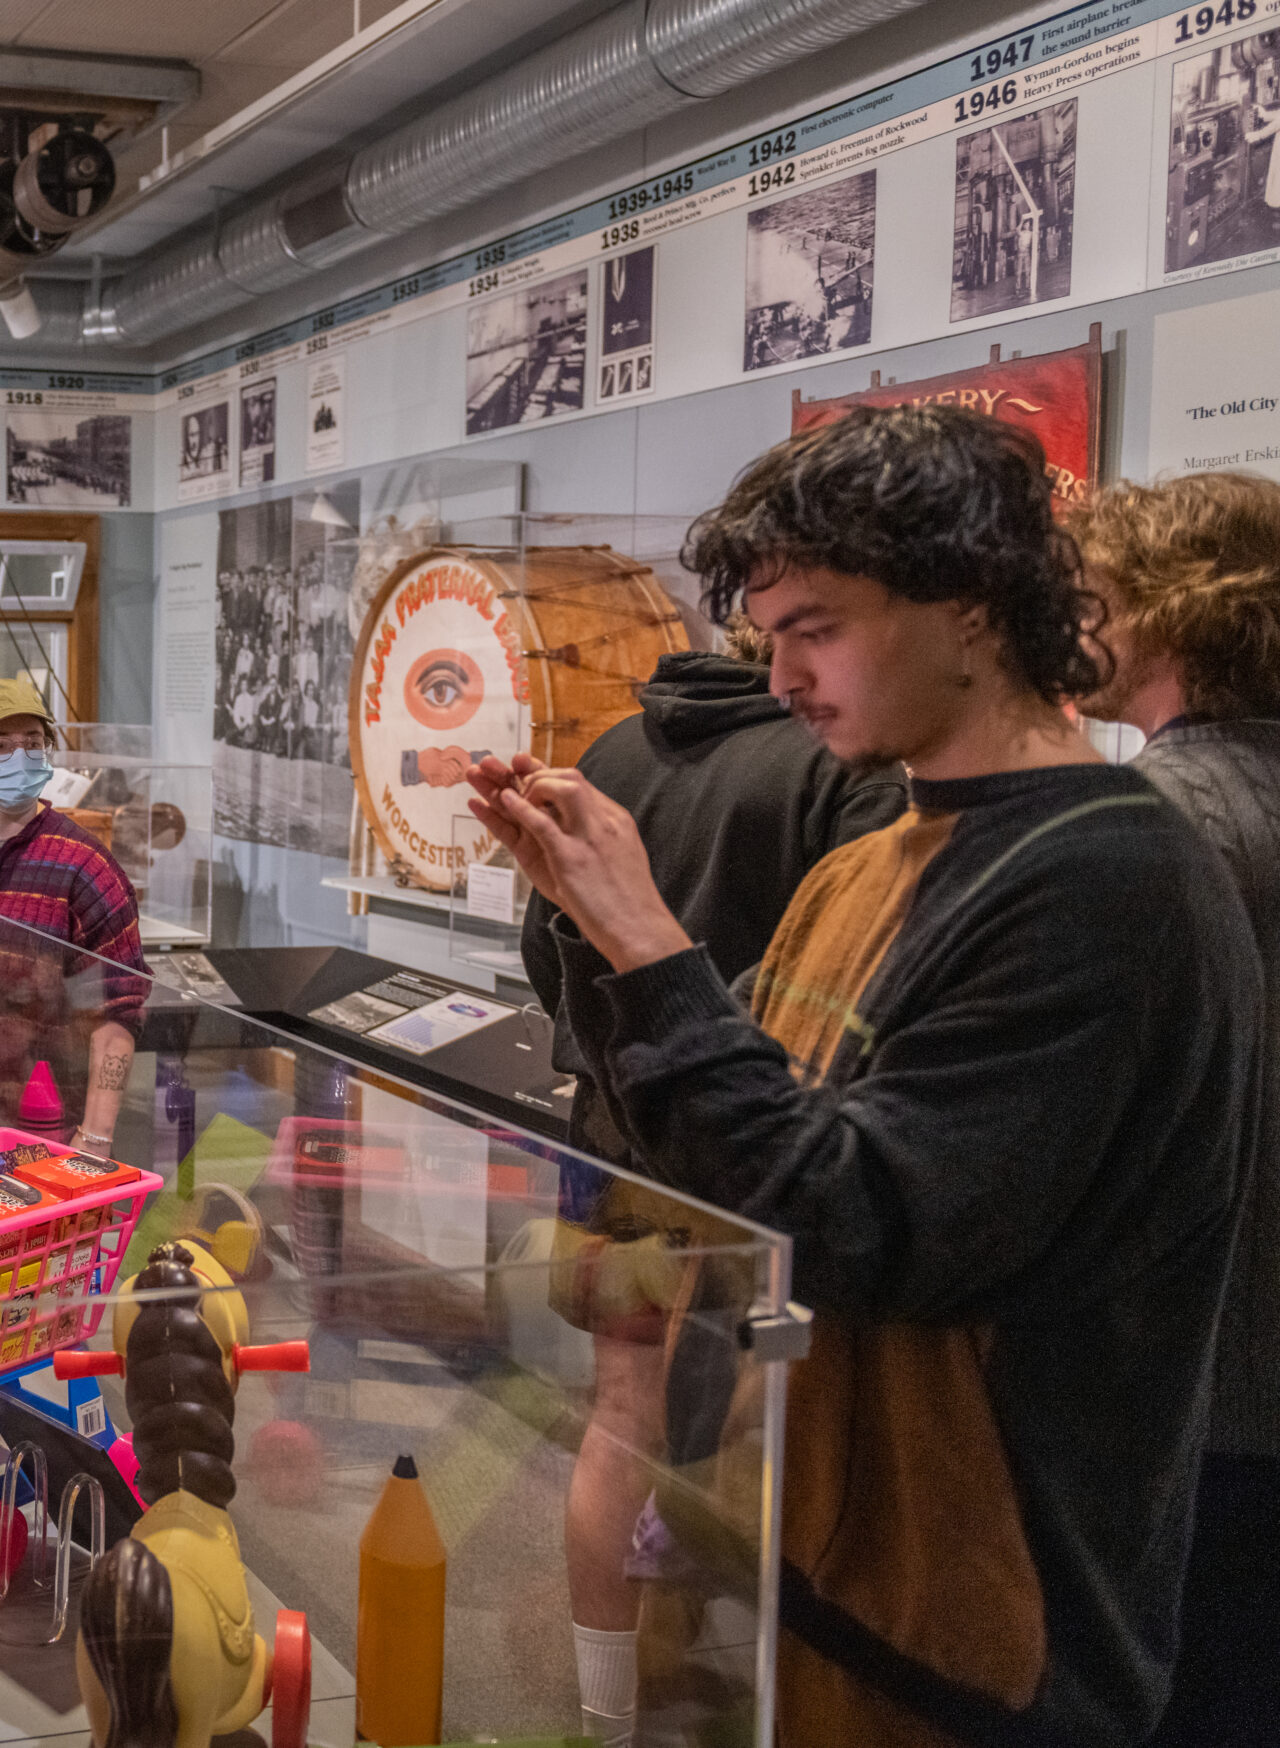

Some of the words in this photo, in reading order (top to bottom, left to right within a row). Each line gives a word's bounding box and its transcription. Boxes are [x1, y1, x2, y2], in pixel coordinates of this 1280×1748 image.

[1041, 26, 1065, 41] First
[1066, 7, 1110, 33] airplane
[1041, 43, 1058, 56] the
[1060, 30, 1091, 52] sound
[1094, 15, 1132, 41] barrier
[1175, 0, 1257, 44] 1948
[970, 34, 1035, 82] 1947
[1023, 49, 1103, 84] Wyman-Gordon
[1105, 35, 1140, 56] begins
[1023, 82, 1054, 99] Heavy
[1055, 72, 1082, 88] Press
[1084, 50, 1141, 77] operations
[801, 121, 818, 136] First
[818, 108, 855, 129] electronic
[856, 93, 895, 114] computer
[954, 79, 1017, 123] 1946
[748, 131, 796, 167] 1942
[799, 160, 834, 180] Sprinkler
[835, 150, 863, 167] invents
[865, 144, 879, 157] fog
[879, 134, 905, 150] nozzle
[800, 150, 829, 168] Howard
[839, 132, 874, 153] Freeman
[875, 126, 885, 139] of
[885, 112, 928, 136] Rockwood
[608, 171, 694, 219] 1939-1945
[748, 162, 795, 197] 1942
[601, 219, 639, 250] 1938
[476, 244, 505, 271] 1935
[469, 271, 498, 297] 1934
[6, 391, 43, 405] 1918
[48, 375, 85, 389] 1920
[1186, 406, 1217, 420] "The
[1220, 400, 1246, 416] Old
[1249, 397, 1279, 412] City
[1183, 453, 1240, 470] Margaret
[1246, 446, 1280, 462] Erski
